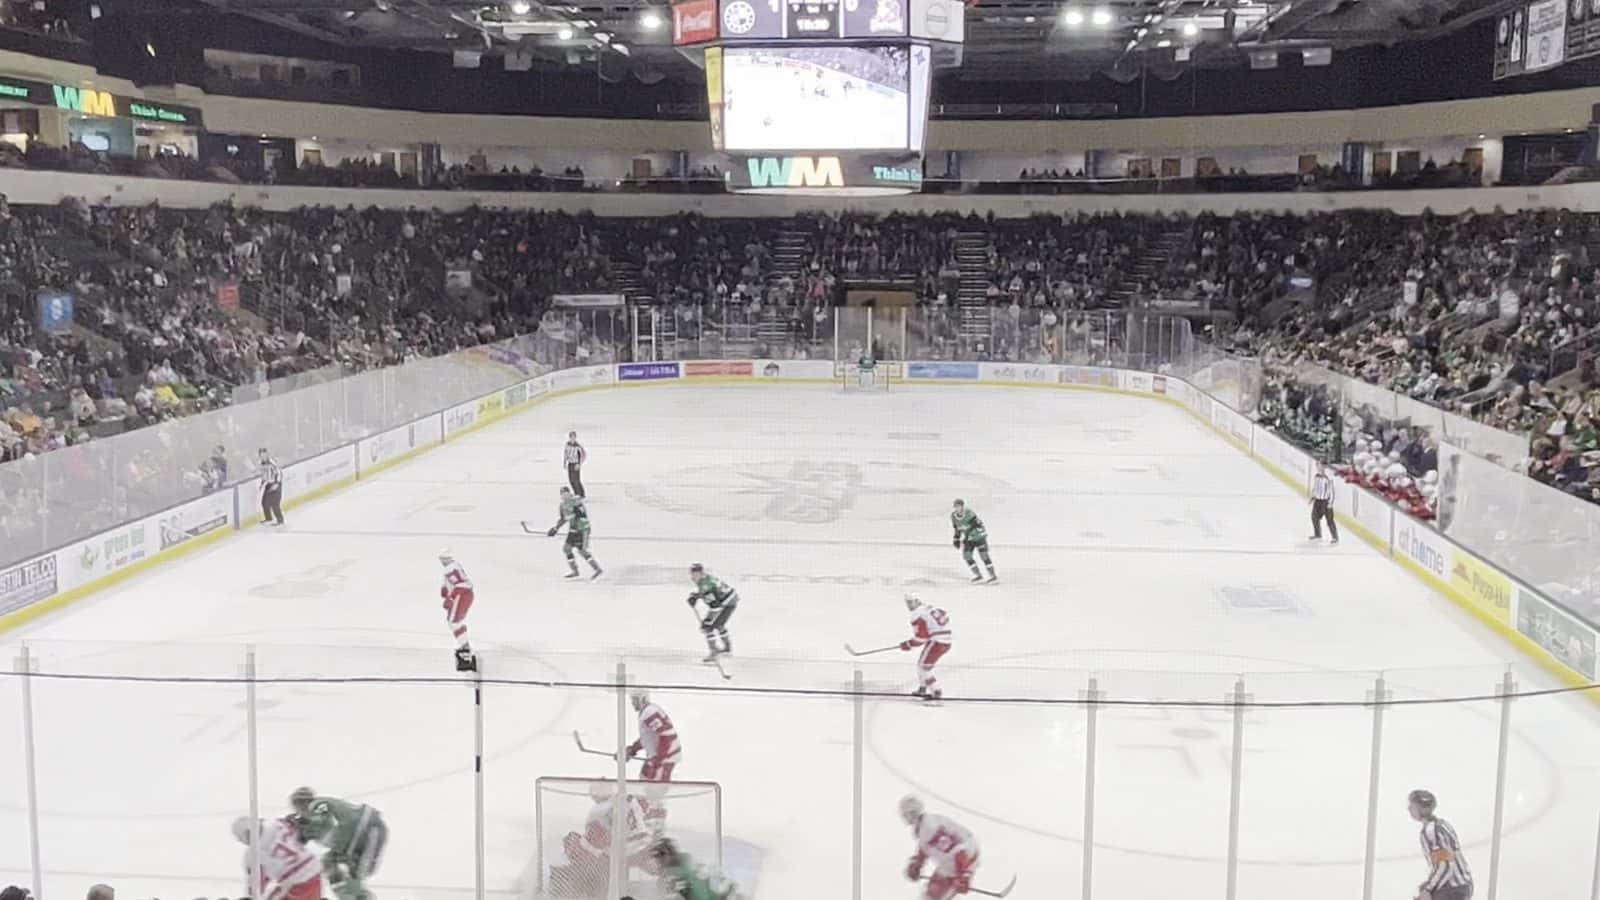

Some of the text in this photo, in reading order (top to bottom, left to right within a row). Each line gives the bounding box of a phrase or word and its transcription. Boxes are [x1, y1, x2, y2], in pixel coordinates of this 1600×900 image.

[52, 84, 116, 117] WM
[747, 157, 843, 187] WM
[24, 556, 56, 585] TELCO
